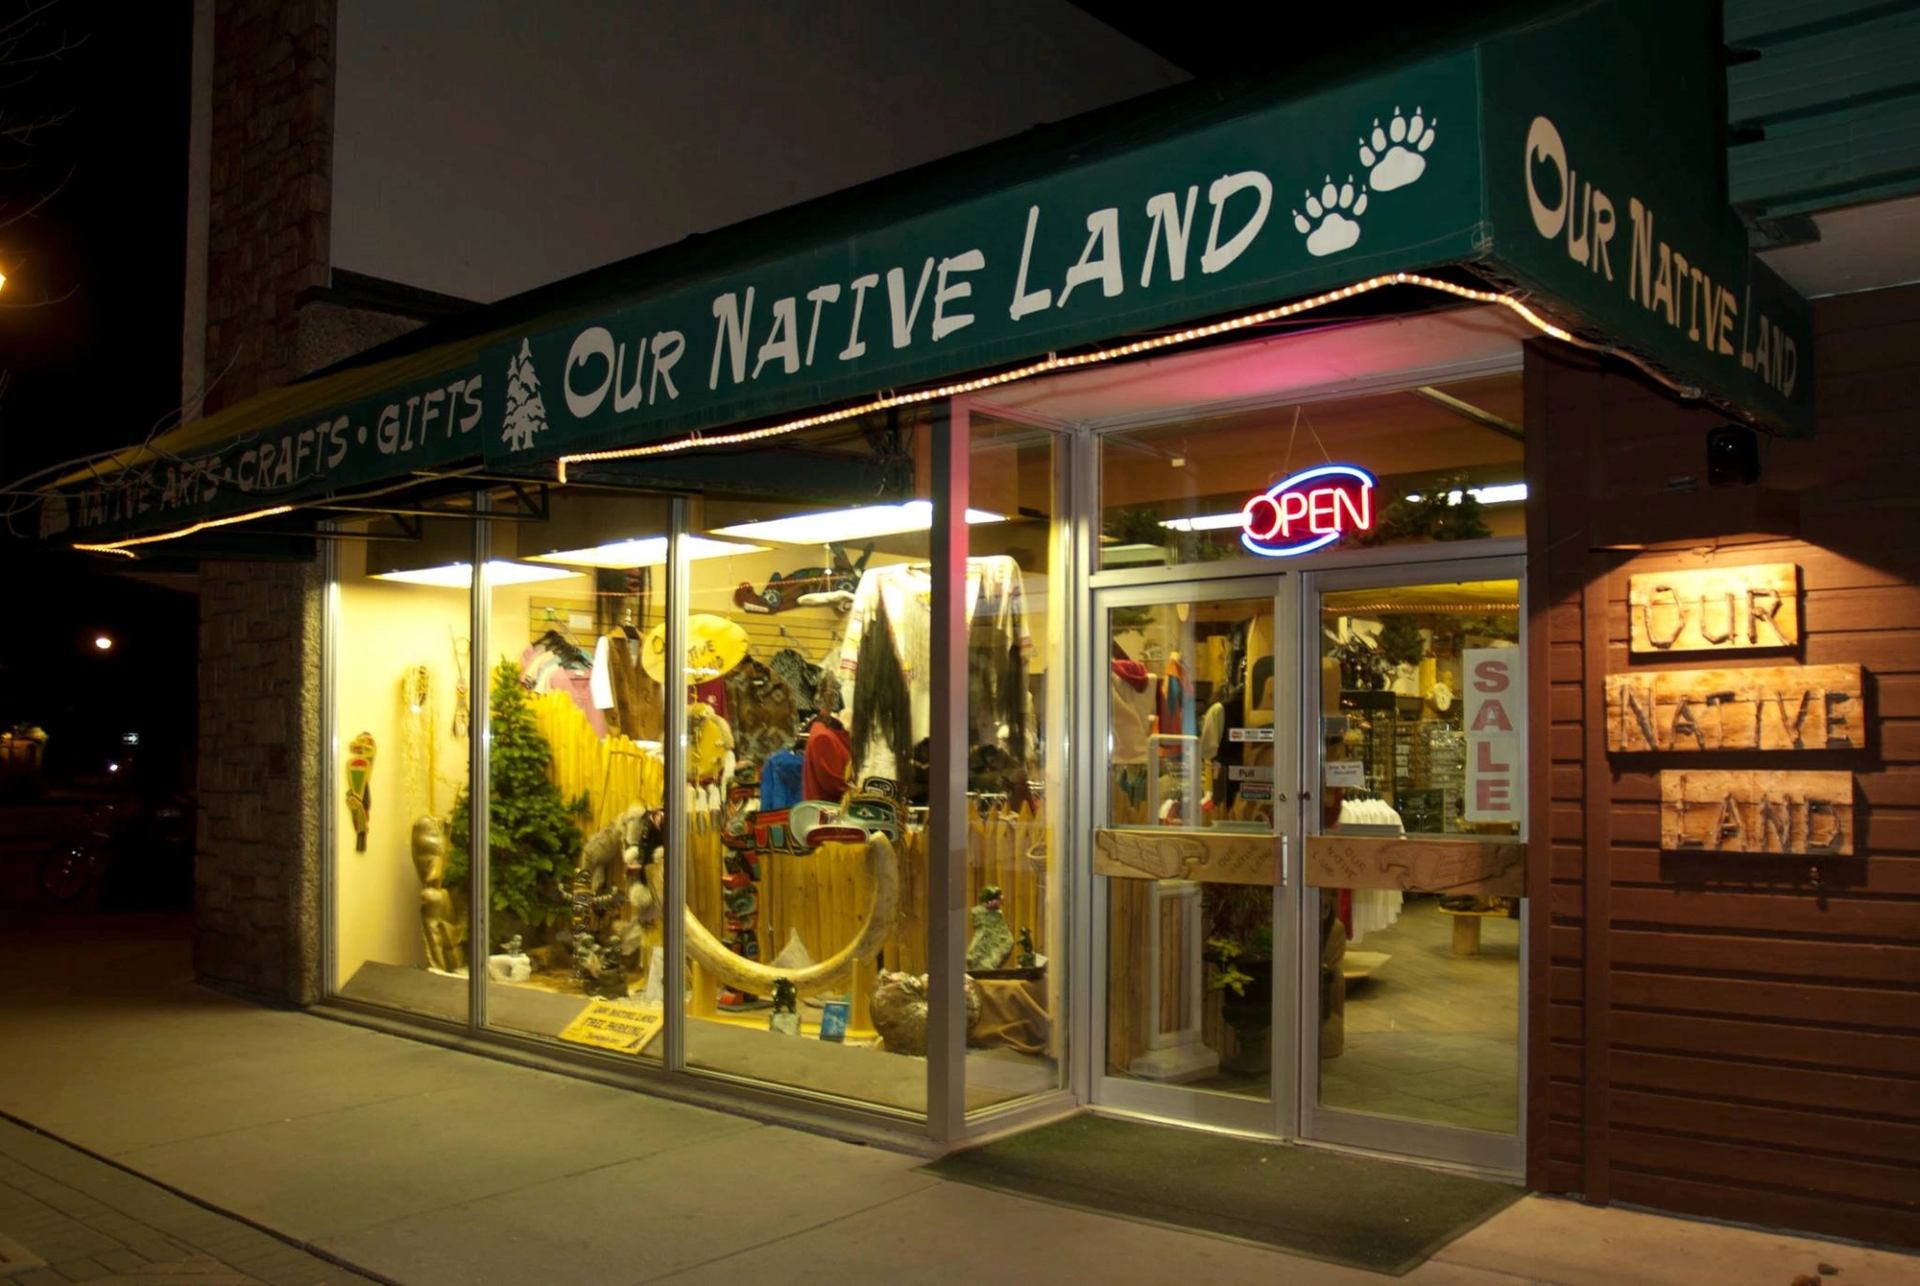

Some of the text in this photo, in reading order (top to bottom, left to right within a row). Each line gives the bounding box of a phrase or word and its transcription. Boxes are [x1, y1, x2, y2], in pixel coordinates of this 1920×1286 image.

[561, 170, 1273, 419] OUR NATIVE LAND
[1525, 115, 1797, 397] OUR NATIVE LAND
[77, 374, 483, 527] NATIVE ARTS CRAFTS GIFTS
[1242, 485, 1374, 540] OPEN
[1643, 586, 1799, 649] OUR
[1470, 660, 1513, 812] SALE
[1619, 685, 1854, 750] NATIVE
[1675, 775, 1843, 851] LAND
